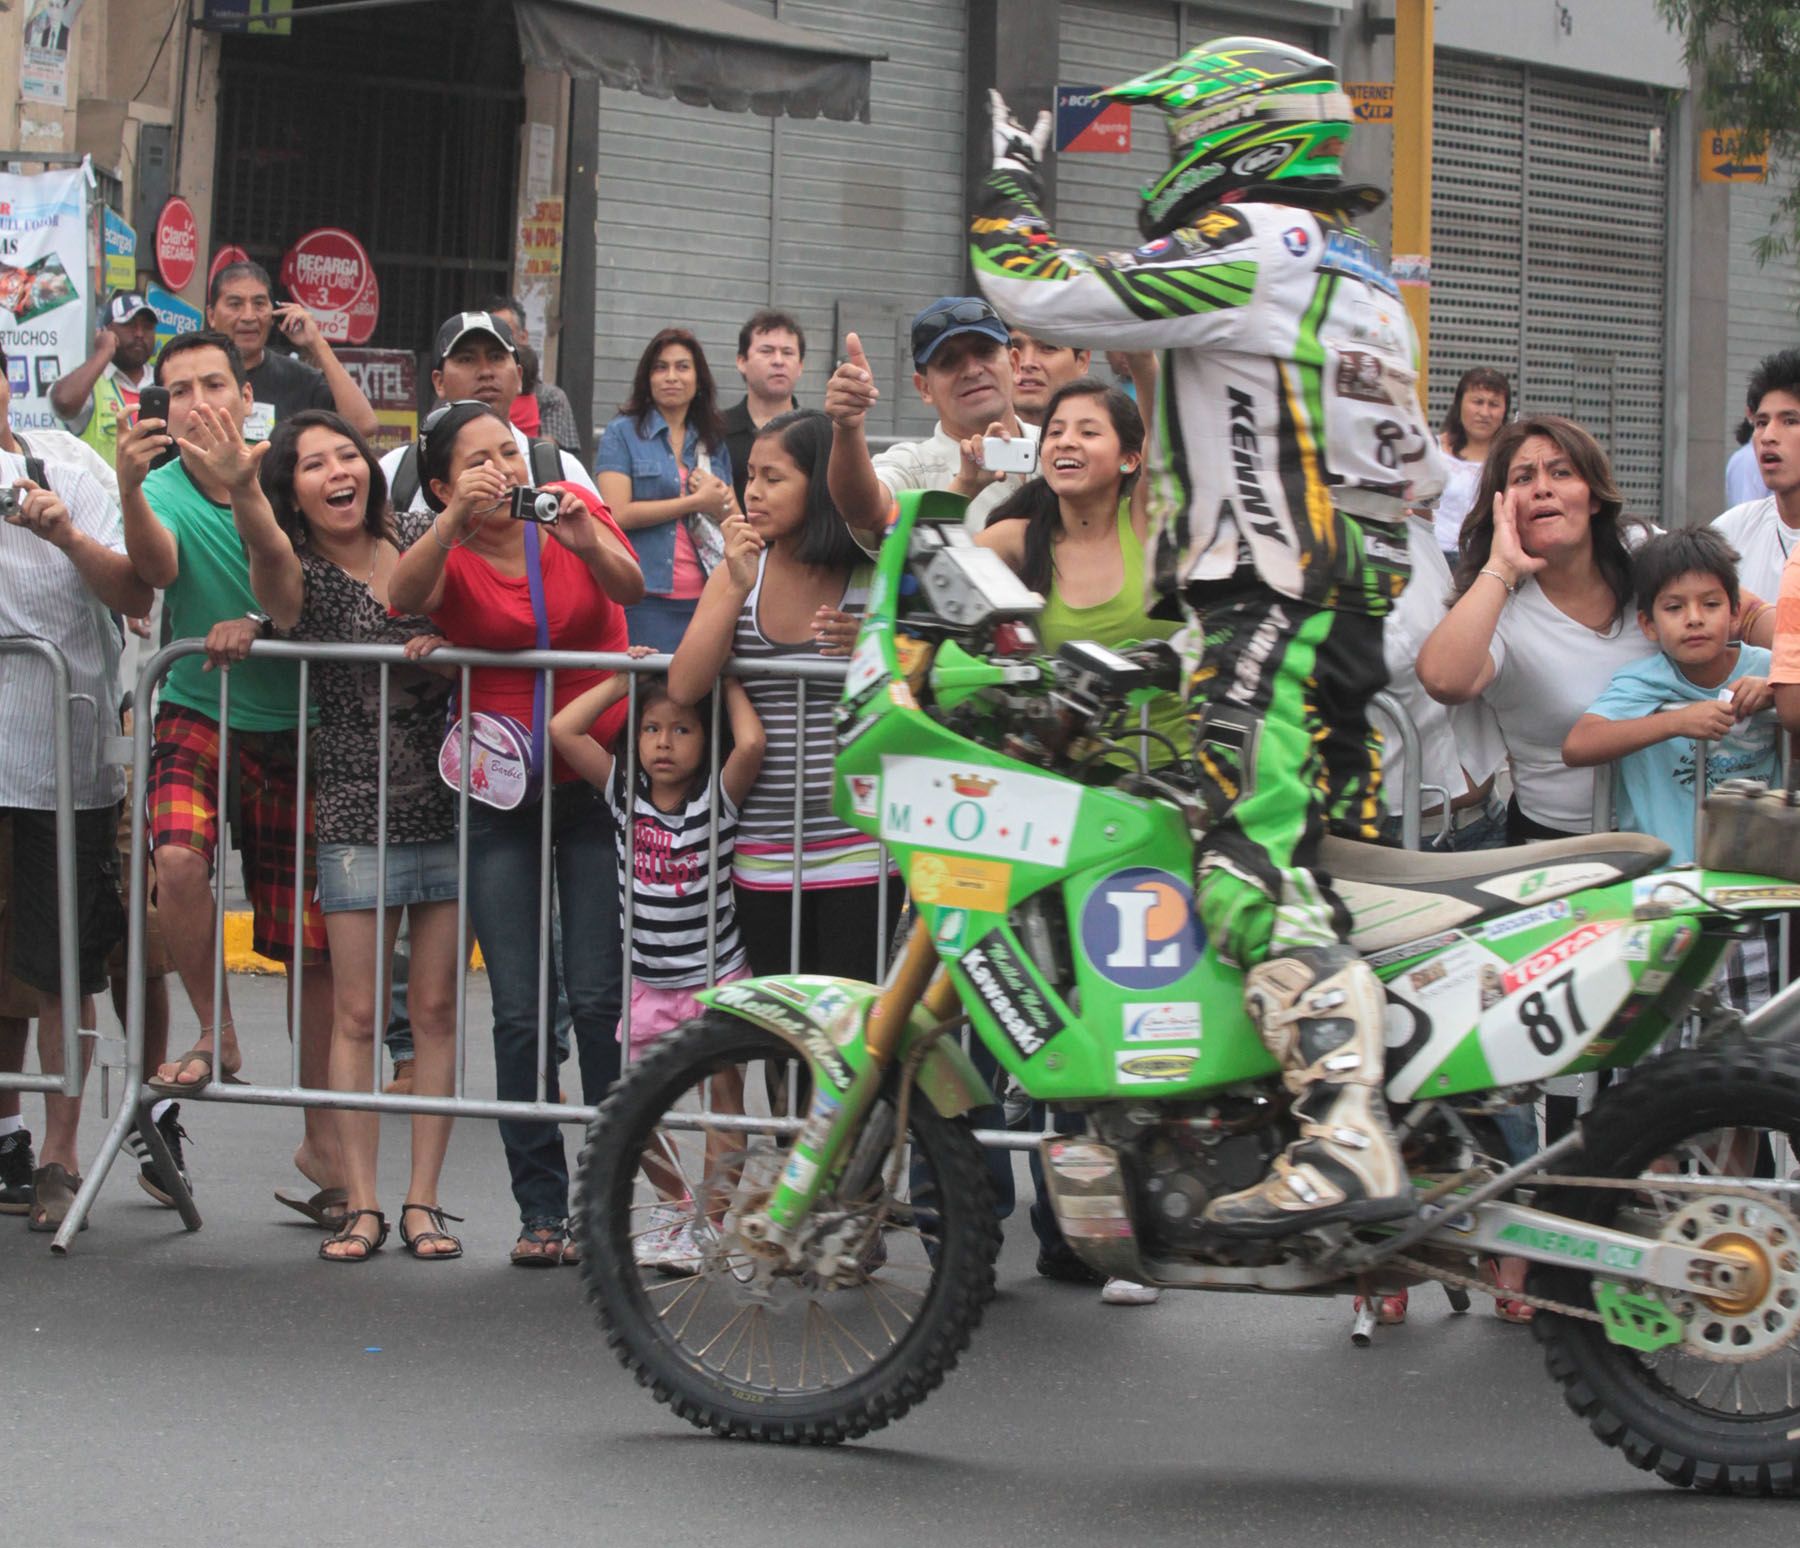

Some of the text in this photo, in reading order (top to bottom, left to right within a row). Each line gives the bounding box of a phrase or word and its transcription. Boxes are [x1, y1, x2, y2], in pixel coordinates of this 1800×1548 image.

[105, 228, 132, 254] ecargas
[297, 253, 359, 277] RECARGA
[316, 286, 329, 305] 3
[155, 308, 197, 334] ecargas
[1226, 384, 1292, 548] KENNY
[491, 759, 523, 780] Barbie
[961, 947, 1045, 1054] Kawasaki
[1517, 969, 1589, 1057] 87
